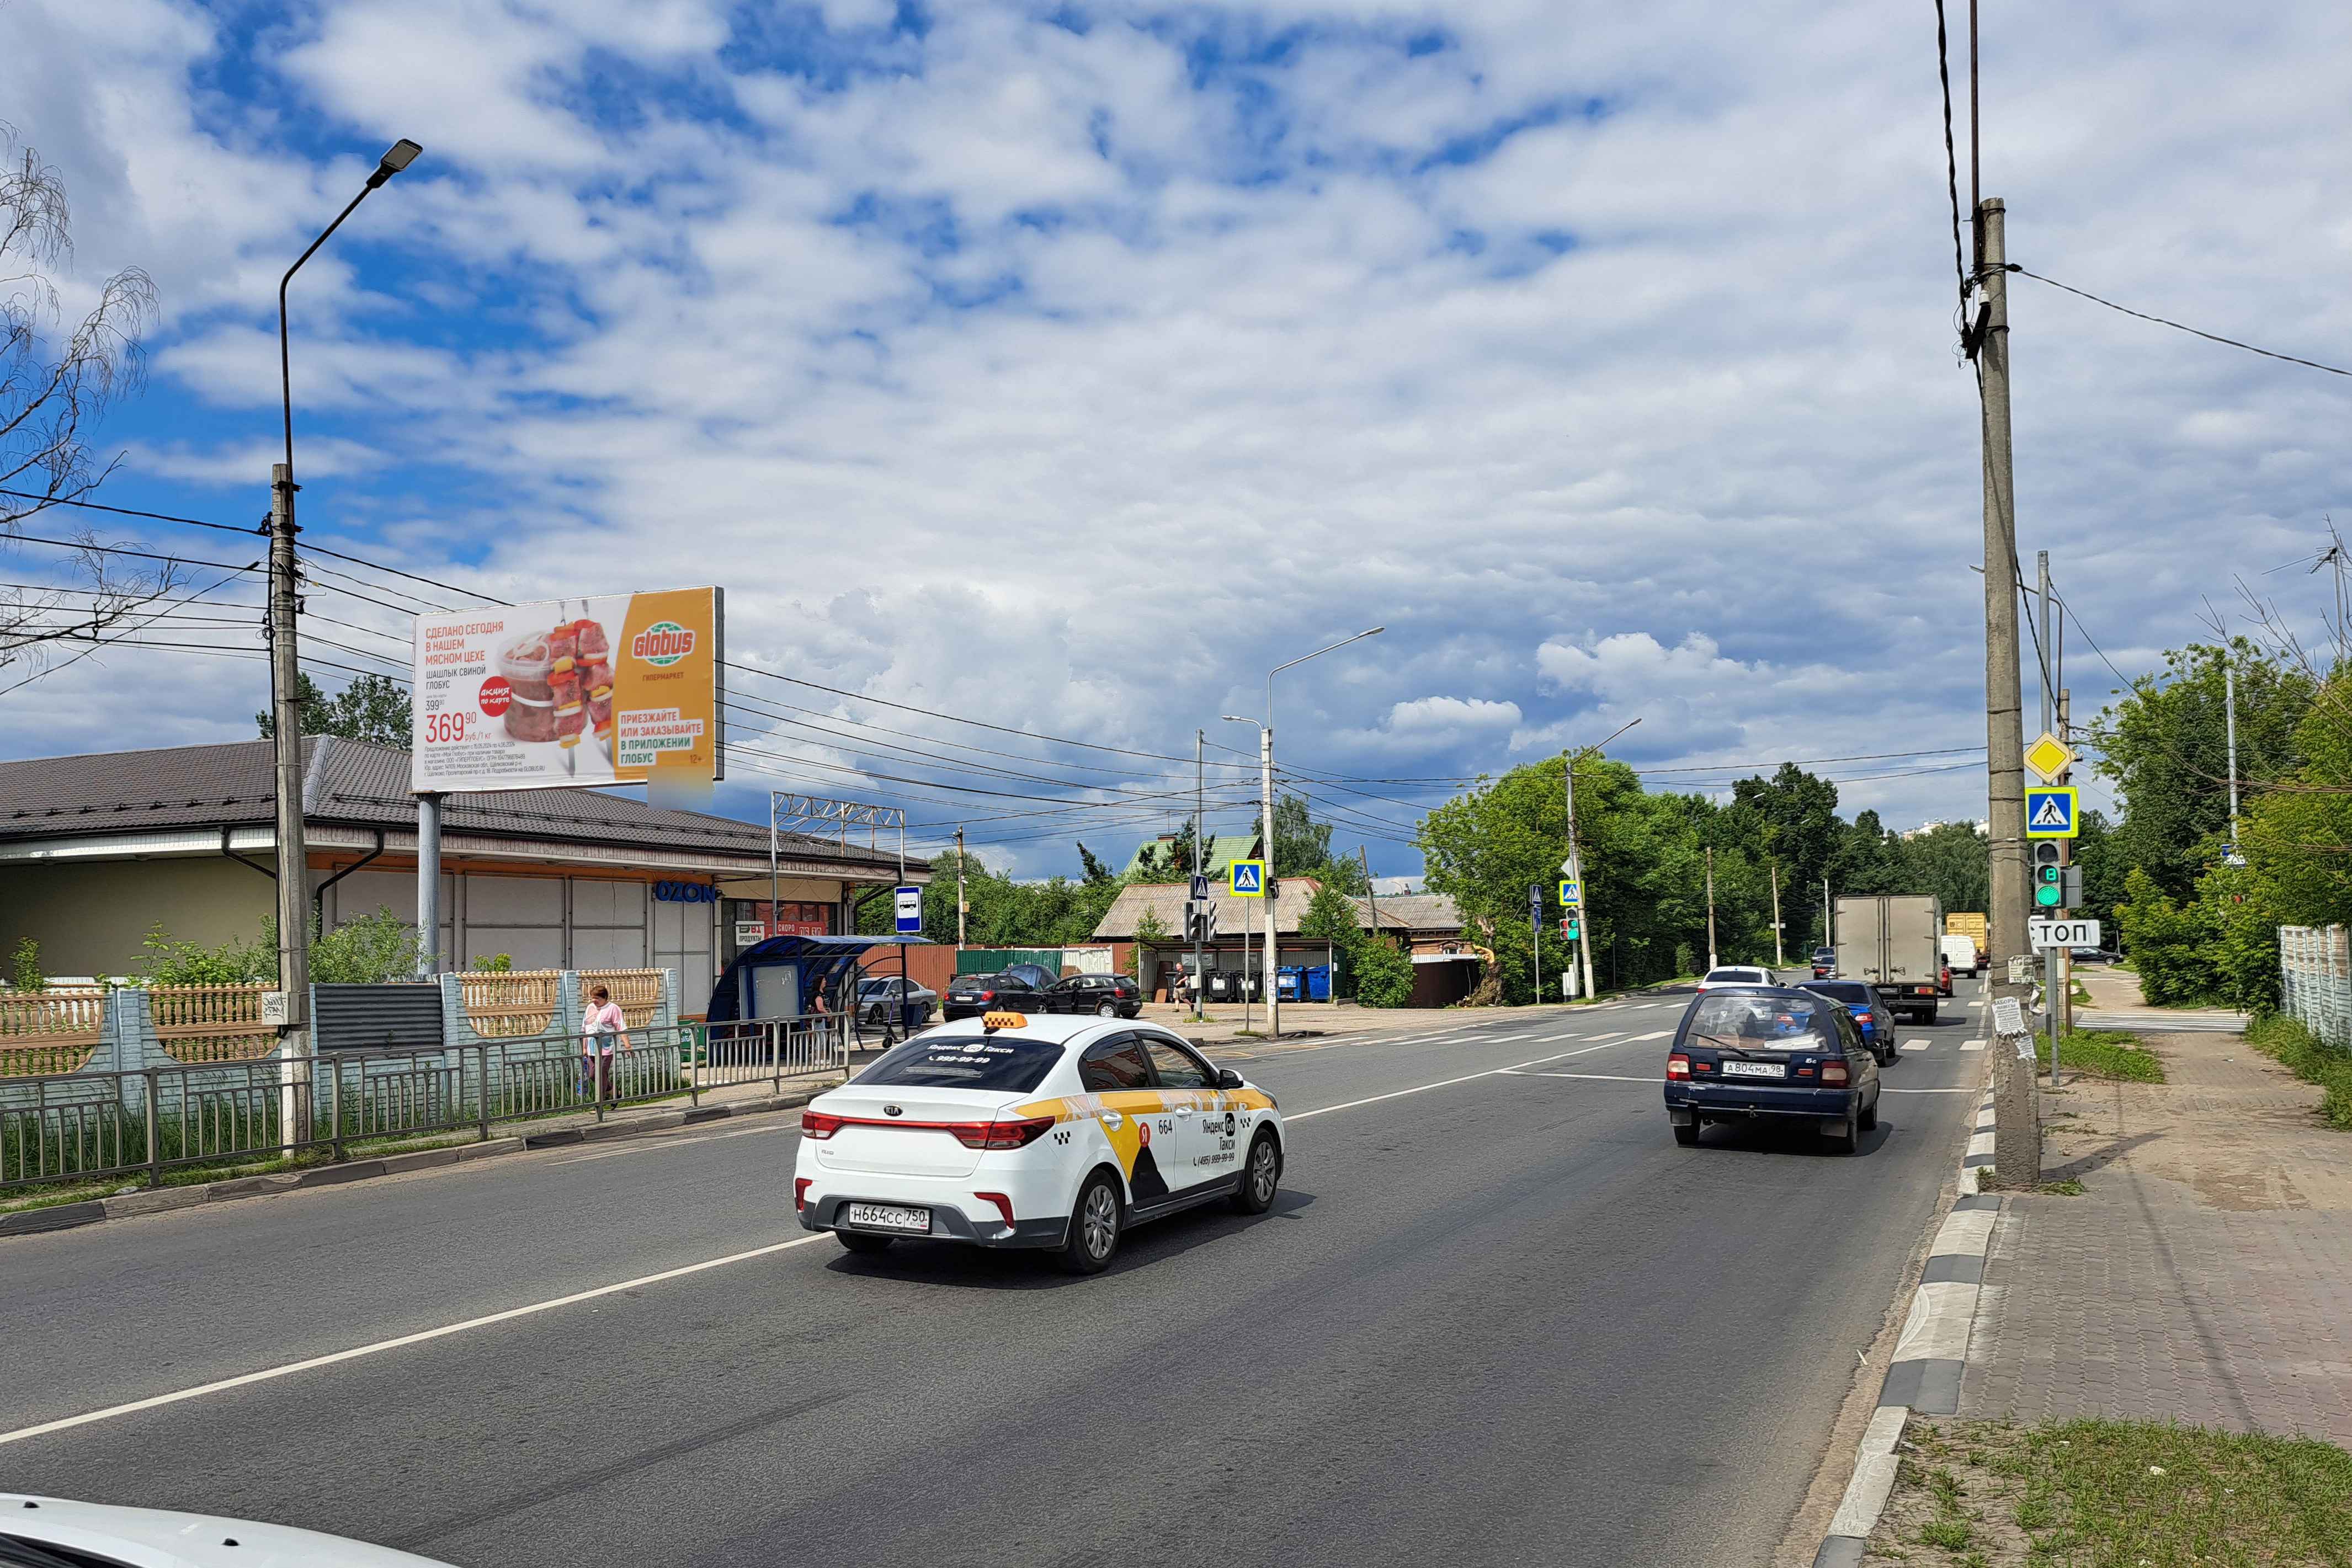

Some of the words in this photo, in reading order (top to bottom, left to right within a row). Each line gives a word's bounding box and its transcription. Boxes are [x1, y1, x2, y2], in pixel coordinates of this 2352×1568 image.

[426, 625, 464, 639] СДЕЛАНО
[466, 622, 503, 634] СЕГОДНЯ
[426, 642, 431, 652] В
[433, 639, 464, 651] НАШЕМ
[634, 630, 693, 657] Globus
[426, 652, 462, 665] МЯСНОМ
[464, 651, 485, 663] ЦЕХЕ
[426, 669, 458, 679] ШАШЛЫК
[459, 664, 486, 676] СВИНОЙ
[642, 672, 684, 682] ГИПЕРМАРКЕТ
[426, 680, 450, 690] ГЛОБУС
[481, 687, 509, 696] акция
[425, 700, 439, 711] 399
[621, 710, 677, 724] ПРИЕЗЖАЙТЕ
[425, 712, 464, 743] 369
[465, 712, 477, 724] 90
[621, 727, 638, 737] ИЛИ
[640, 722, 701, 736] ЗАКАЗЫВАЙТЕ
[621, 741, 626, 750] В
[629, 737, 690, 750] ПРИЛОЖЕНИИ
[621, 753, 653, 764] ГЛОБУС
[690, 754, 702, 764] 12+
[655, 881, 715, 903] OZON
[778, 924, 795, 932] СКОРО
[2031, 925, 2087, 942] ТОП
[984, 1046, 1015, 1054] Такси
[1727, 1064, 1768, 1074] А804МА
[1159, 1119, 1173, 1135] 664
[1203, 1119, 1224, 1135] Яндекс
[1225, 1116, 1234, 1133] Go
[1142, 1126, 1147, 1143] Я
[1219, 1137, 1235, 1151] Такси
[1211, 1152, 1234, 1164] 999-99-99
[854, 1206, 903, 1224] Н664СС
[905, 1209, 925, 1222] 750
